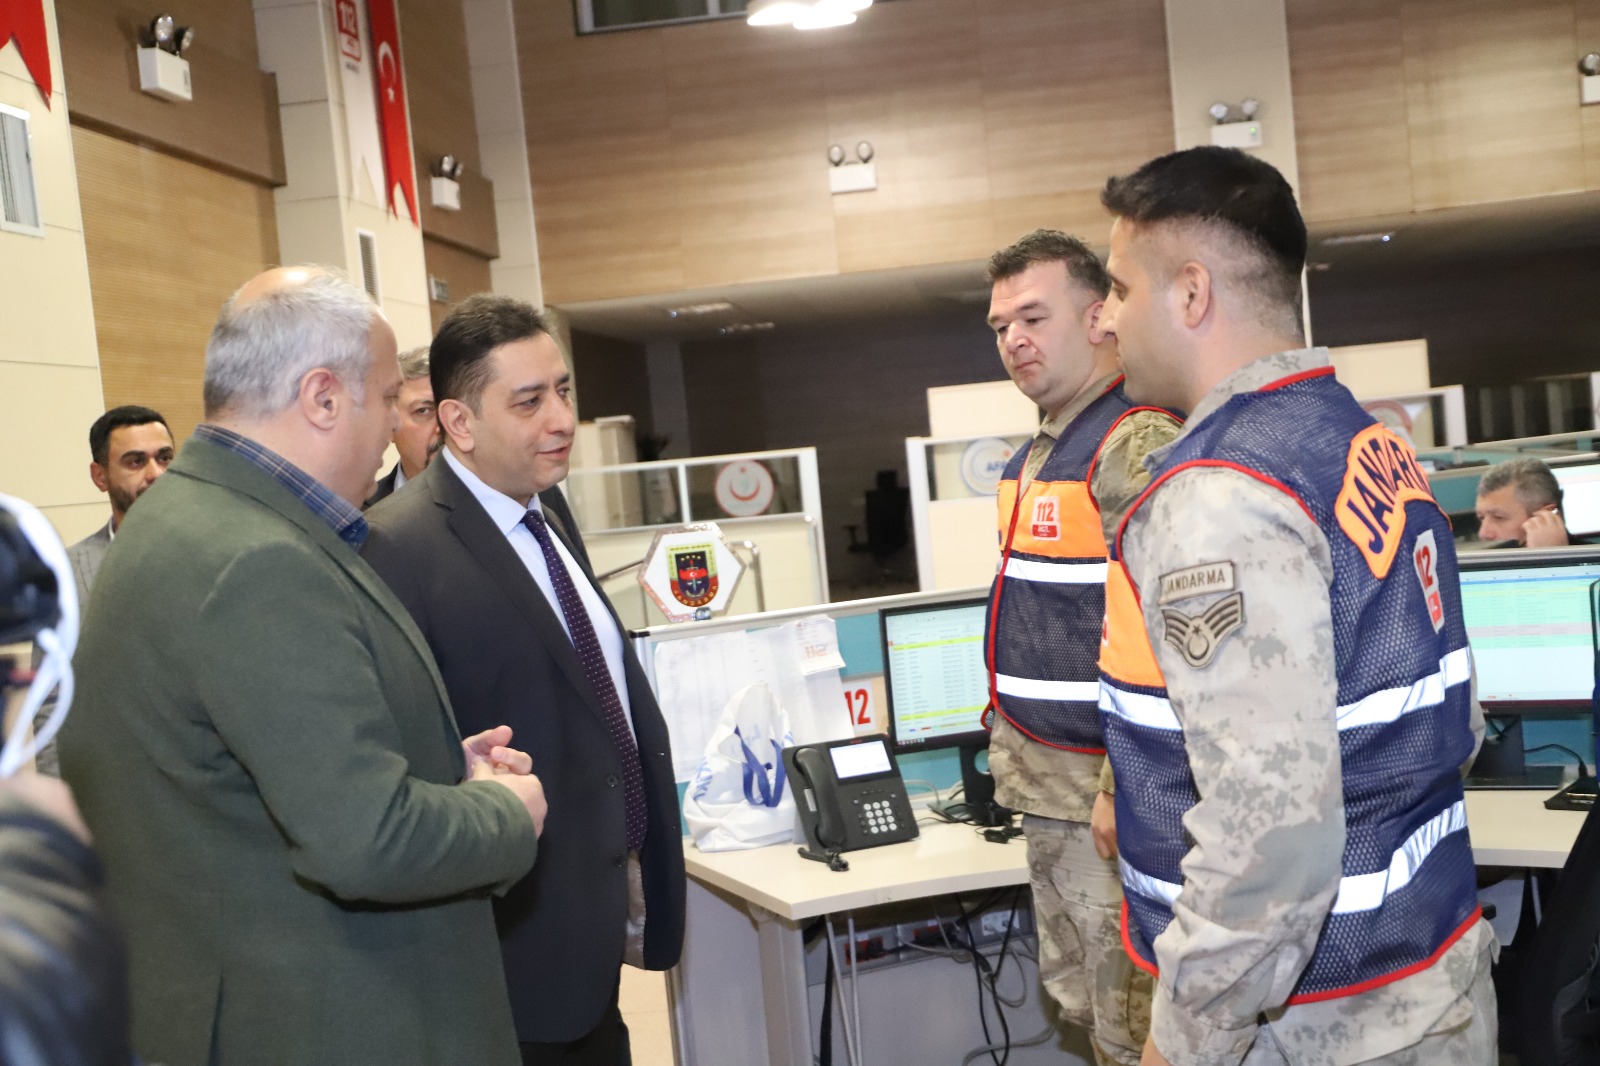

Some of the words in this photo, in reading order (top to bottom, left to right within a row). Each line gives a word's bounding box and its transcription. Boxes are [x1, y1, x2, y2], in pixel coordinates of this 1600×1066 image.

[1036, 502, 1055, 522] 112
[1164, 568, 1226, 598] JANDARMA
[673, 585, 718, 606] JANDARMA
